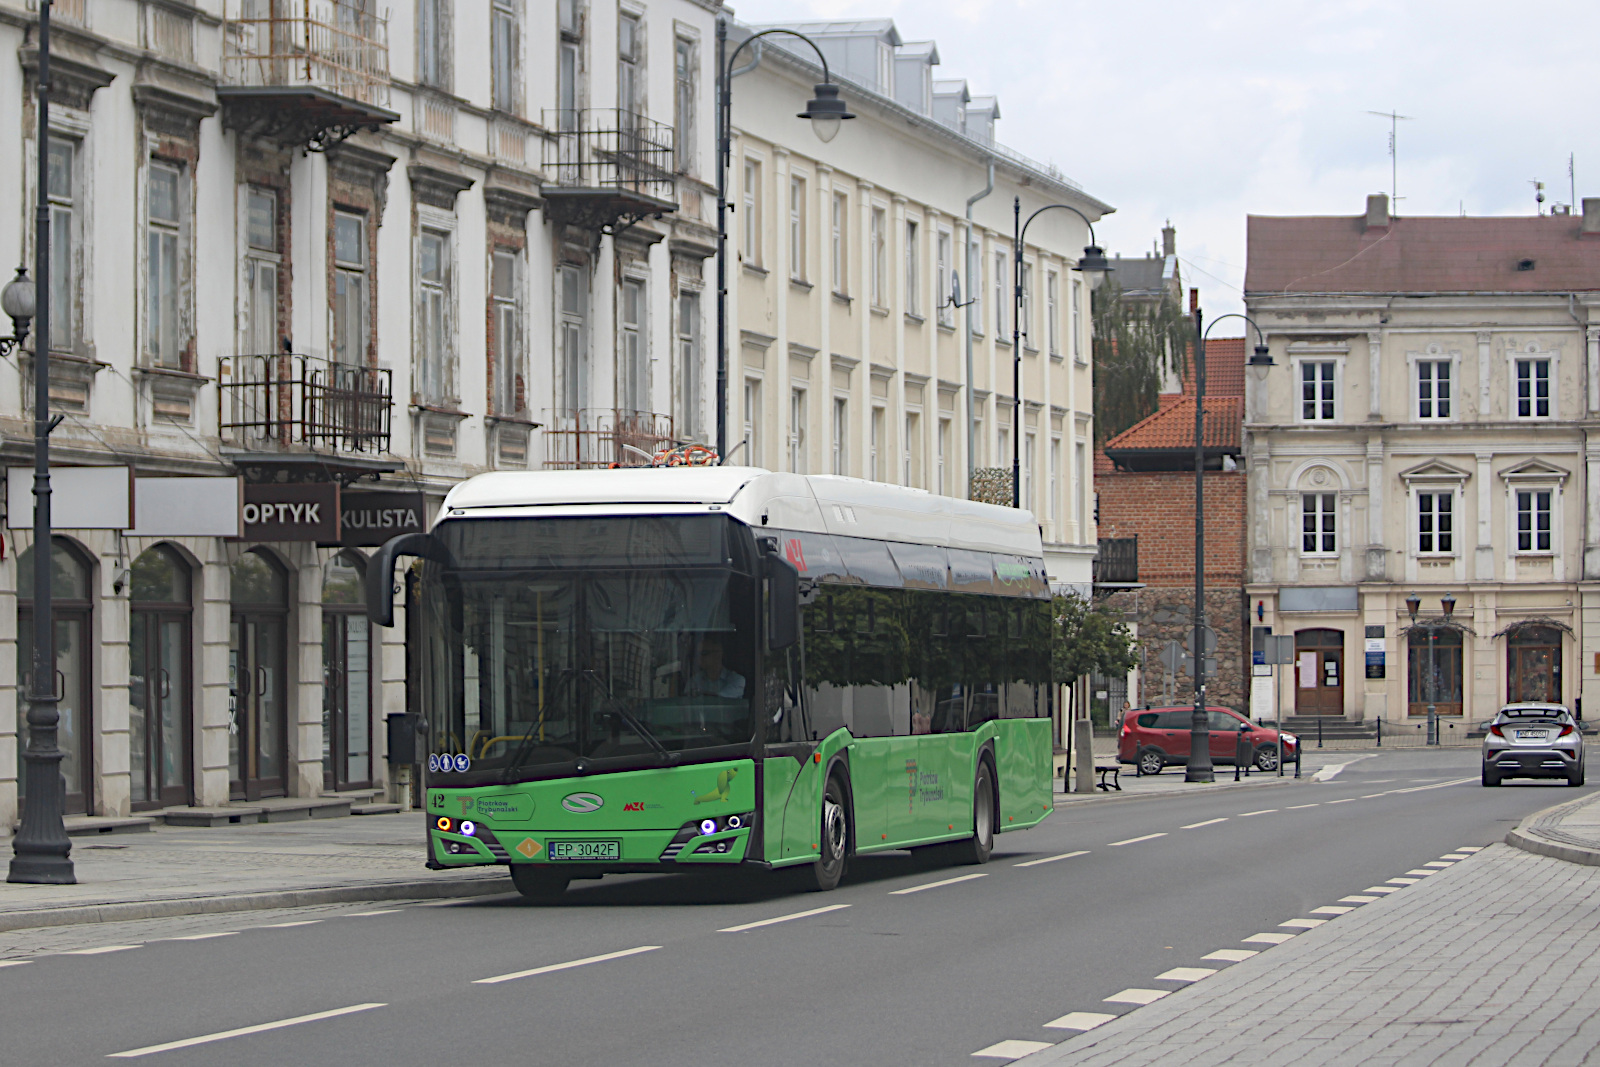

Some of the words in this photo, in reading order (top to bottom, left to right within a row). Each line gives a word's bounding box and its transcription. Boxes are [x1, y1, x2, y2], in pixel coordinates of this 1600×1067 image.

[243, 503, 321, 524] OPTYK
[431, 793, 445, 808] 42
[623, 801, 645, 811] MZK
[557, 844, 573, 855] EP
[577, 844, 615, 855] 3042F
